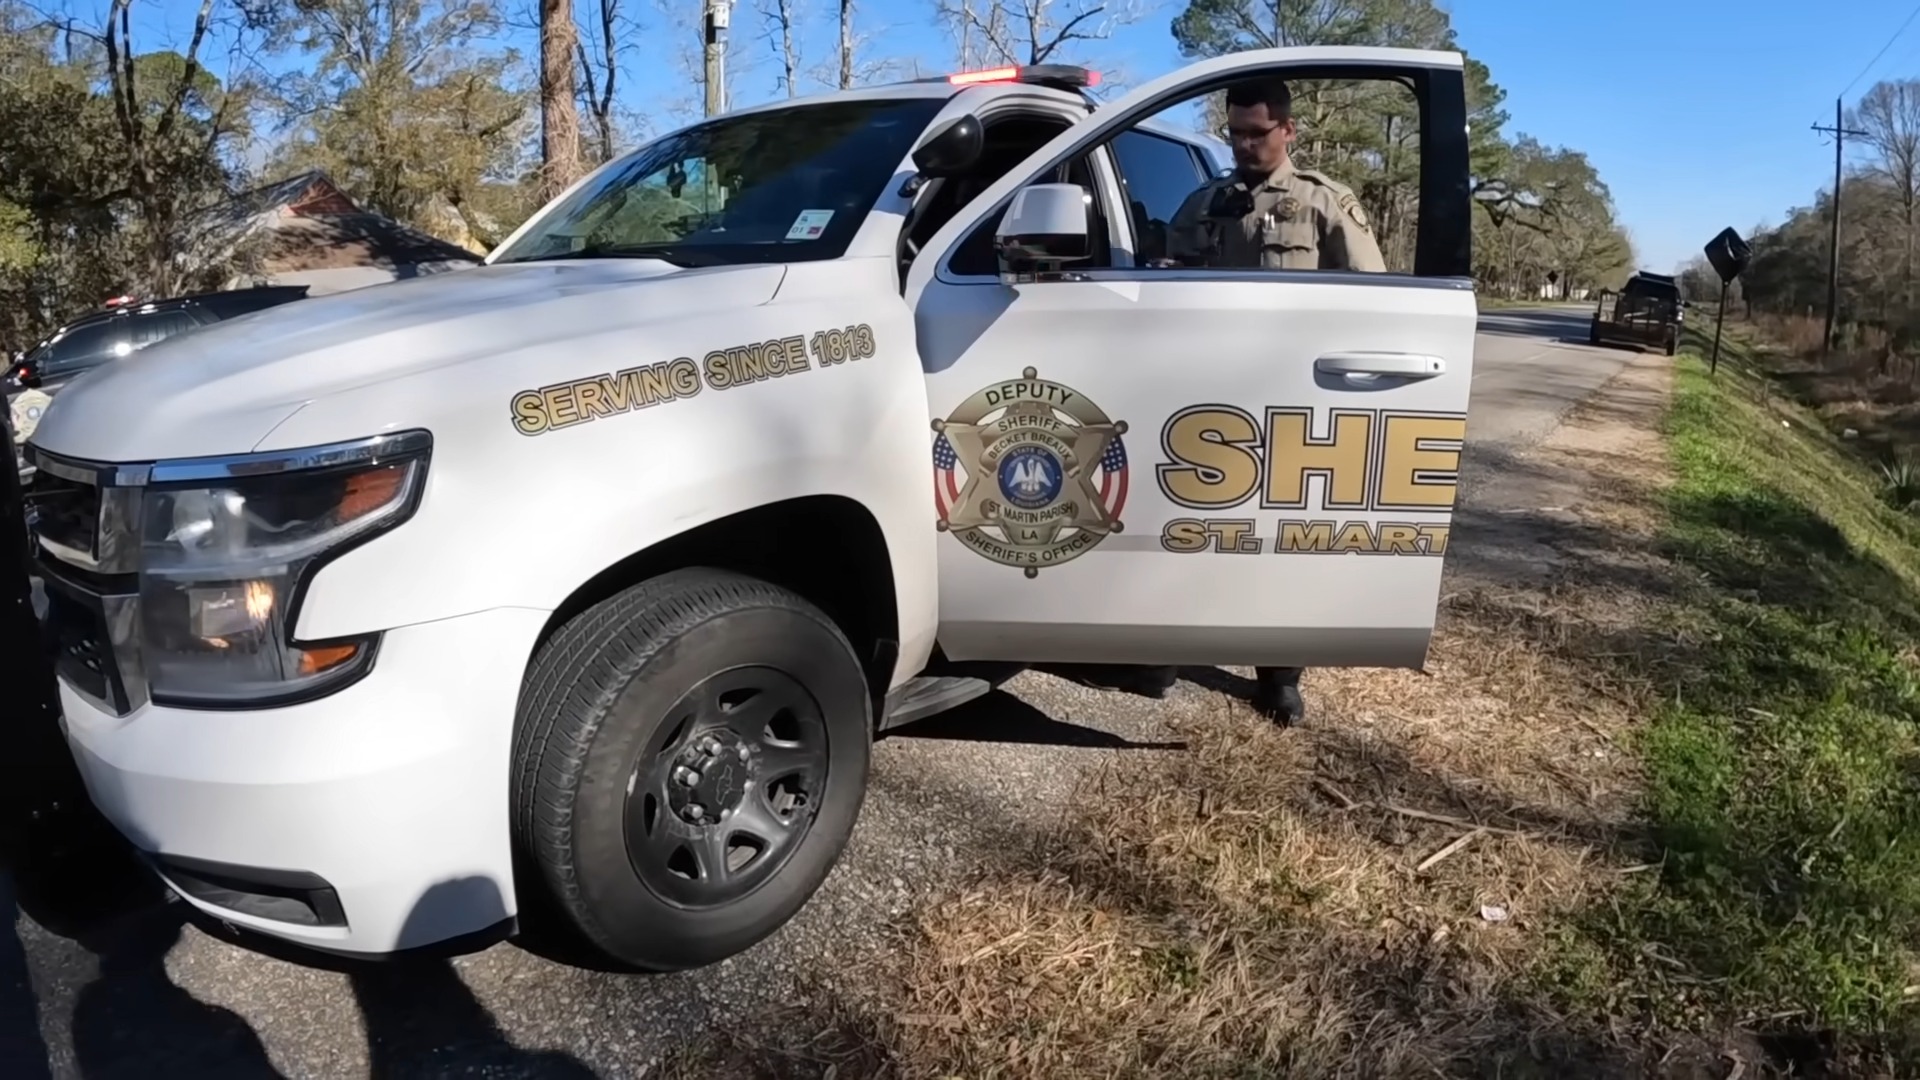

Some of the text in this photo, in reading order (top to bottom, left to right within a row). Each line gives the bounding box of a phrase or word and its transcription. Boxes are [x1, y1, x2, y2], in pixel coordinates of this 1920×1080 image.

[511, 323, 876, 436] SERVING SINCE 1813
[985, 383, 1073, 406] DEPUTY
[998, 415, 1063, 432] SHERIFF
[988, 432, 1027, 460] BECKET
[1031, 432, 1072, 461] BREAUX
[1155, 403, 1467, 512] SHE
[1004, 507, 1038, 523] MARTIN
[1040, 502, 1073, 521] PARISH
[965, 530, 1092, 563] SHERIFF'S OFFICE
[1021, 530, 1038, 540] LA
[1161, 518, 1451, 556] ST. MART
